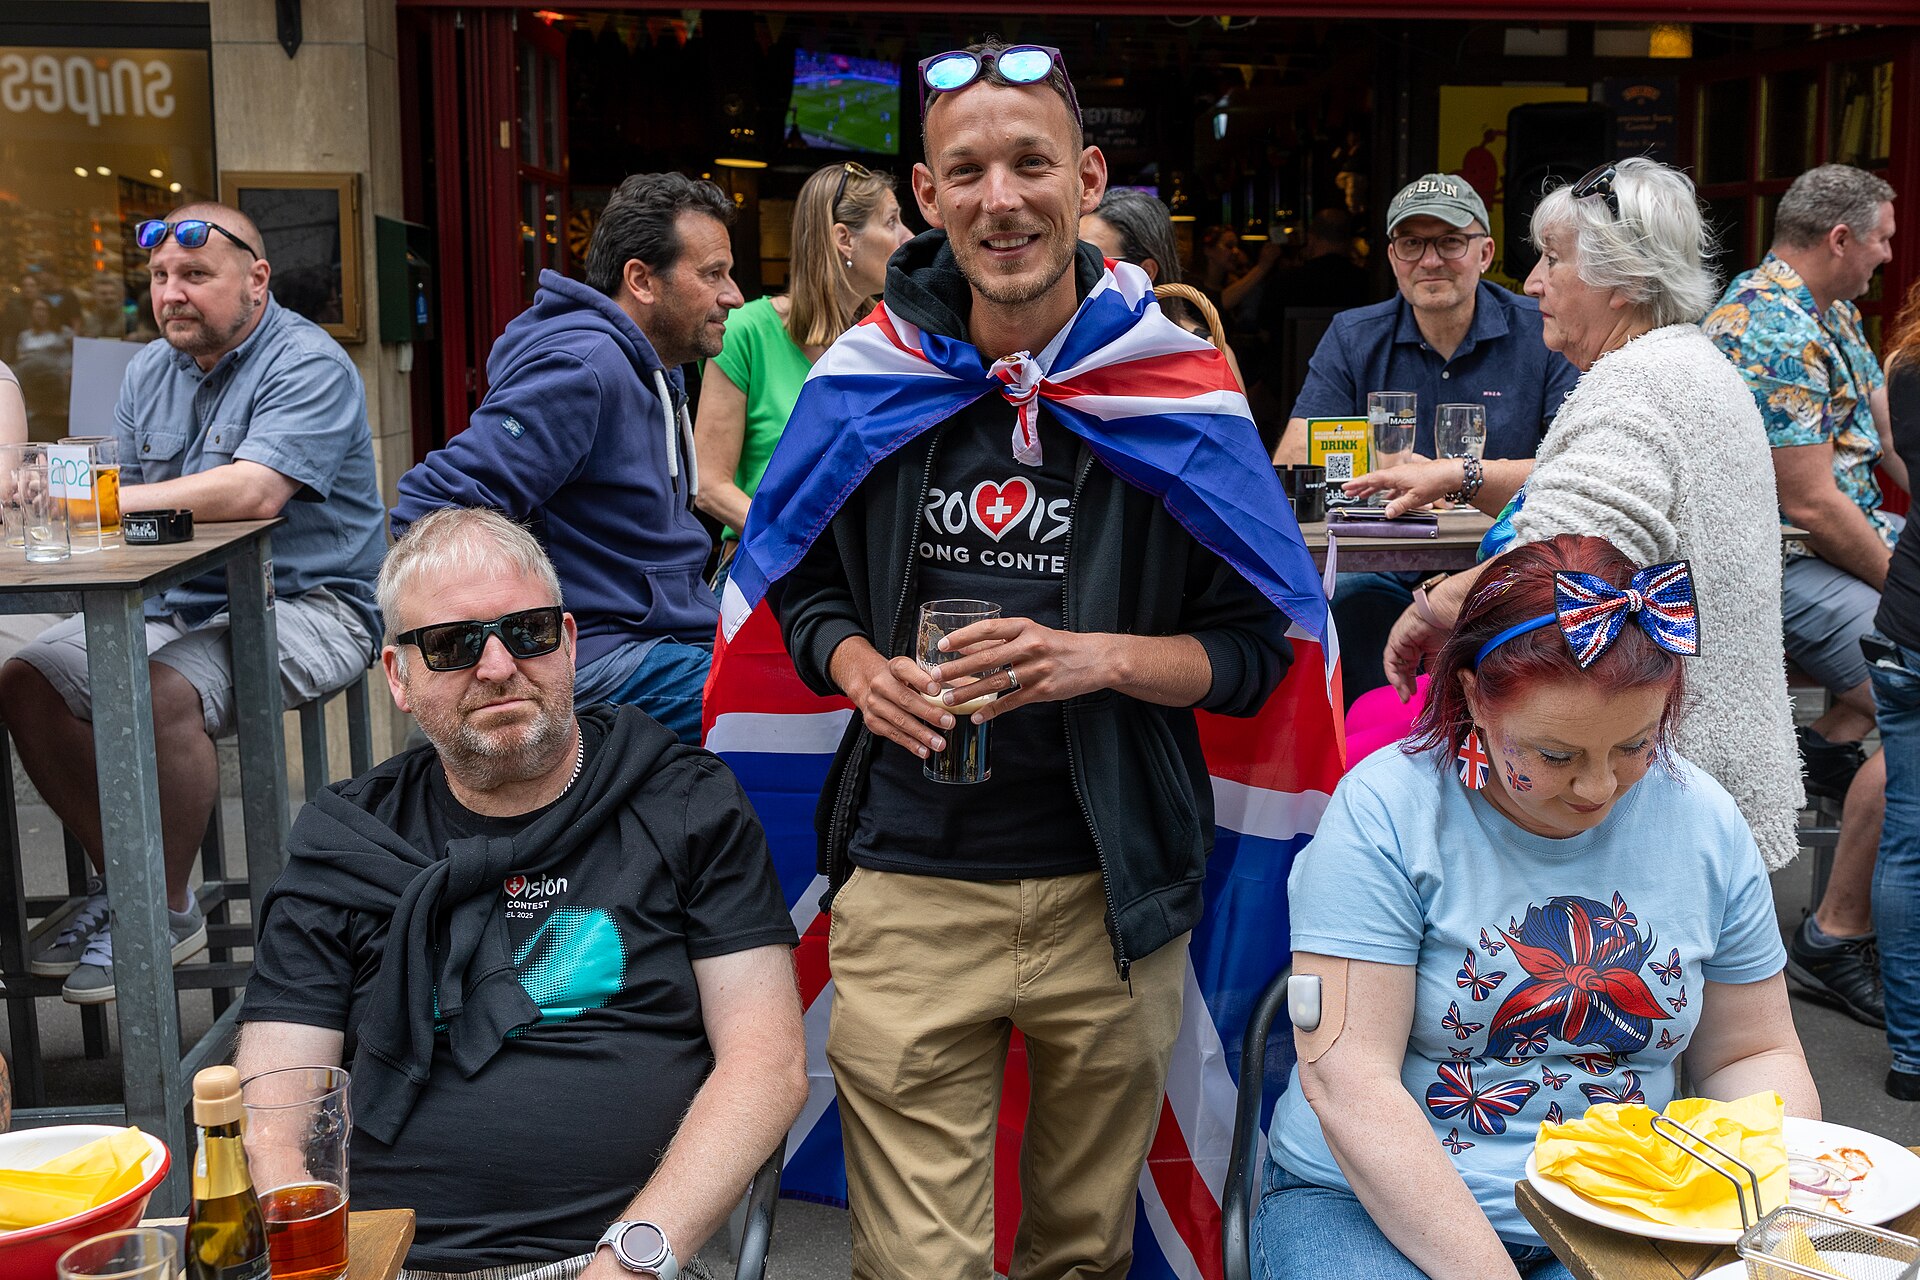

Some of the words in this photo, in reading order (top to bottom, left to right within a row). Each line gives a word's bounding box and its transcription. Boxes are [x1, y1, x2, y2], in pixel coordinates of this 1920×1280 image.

[1399, 181, 1458, 208] DUBLIN
[1321, 440, 1358, 451] DRINK
[980, 550, 1065, 574] CONTE
[507, 901, 550, 910] CONTEST
